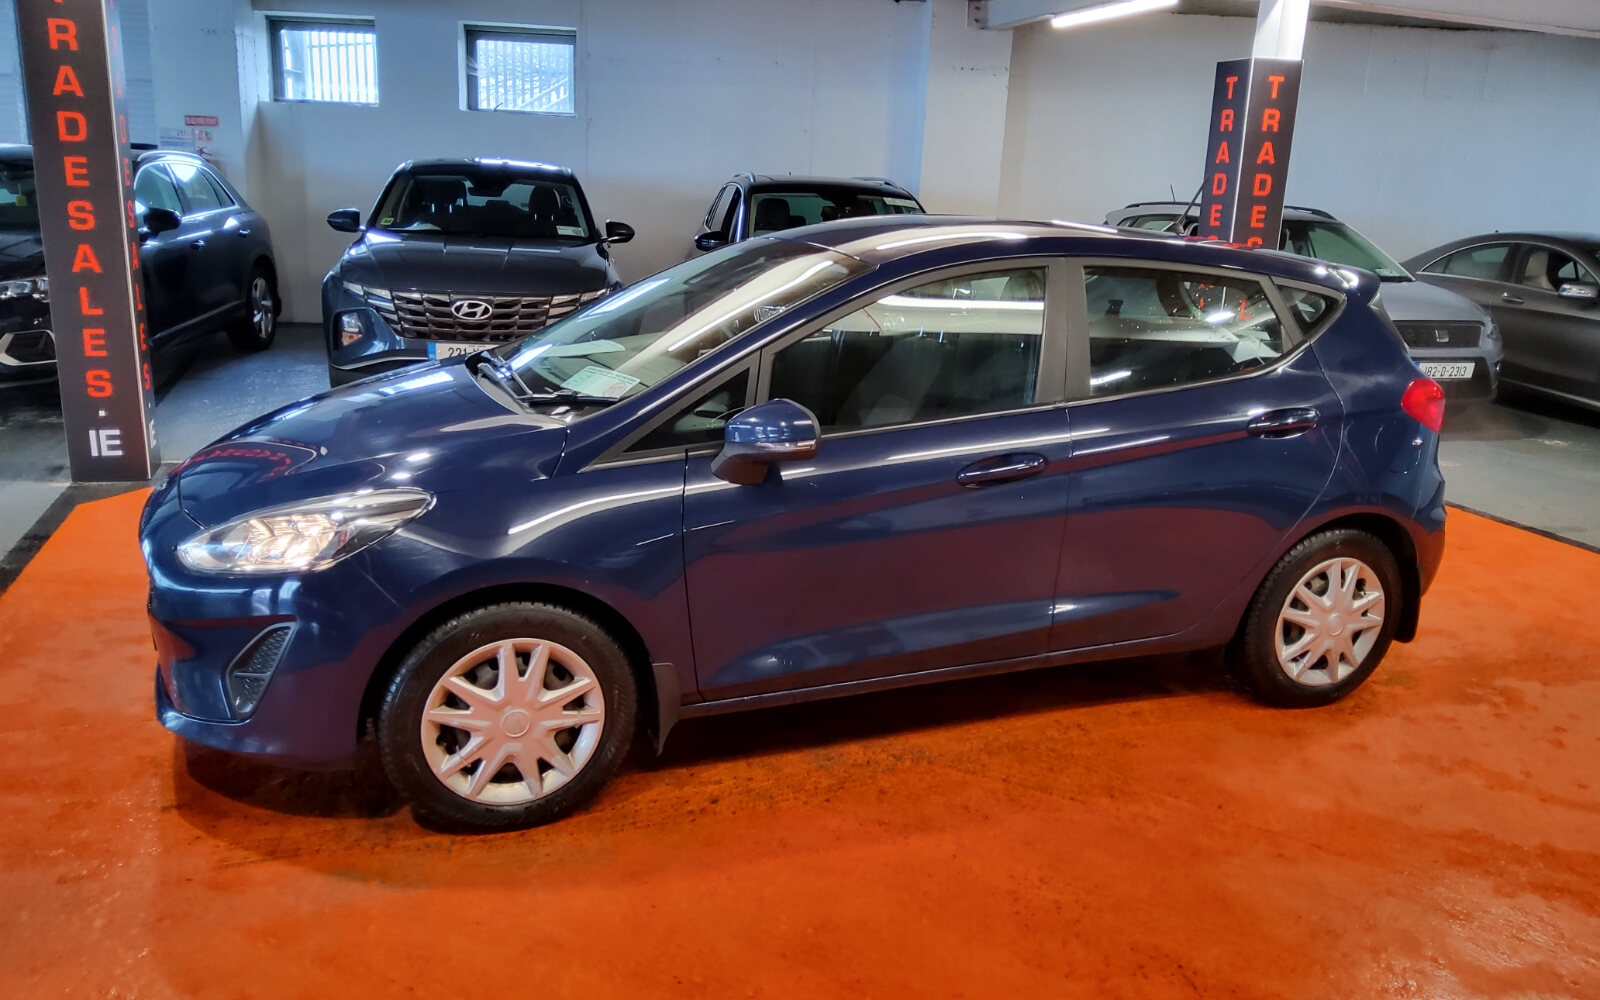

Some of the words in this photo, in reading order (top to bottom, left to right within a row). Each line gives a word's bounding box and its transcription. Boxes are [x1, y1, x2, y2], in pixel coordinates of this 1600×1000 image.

[47, 0, 123, 457] RADESALES.IE
[1208, 76, 1239, 240] TRADE
[1424, 366, 1468, 377] 182-D-2313
